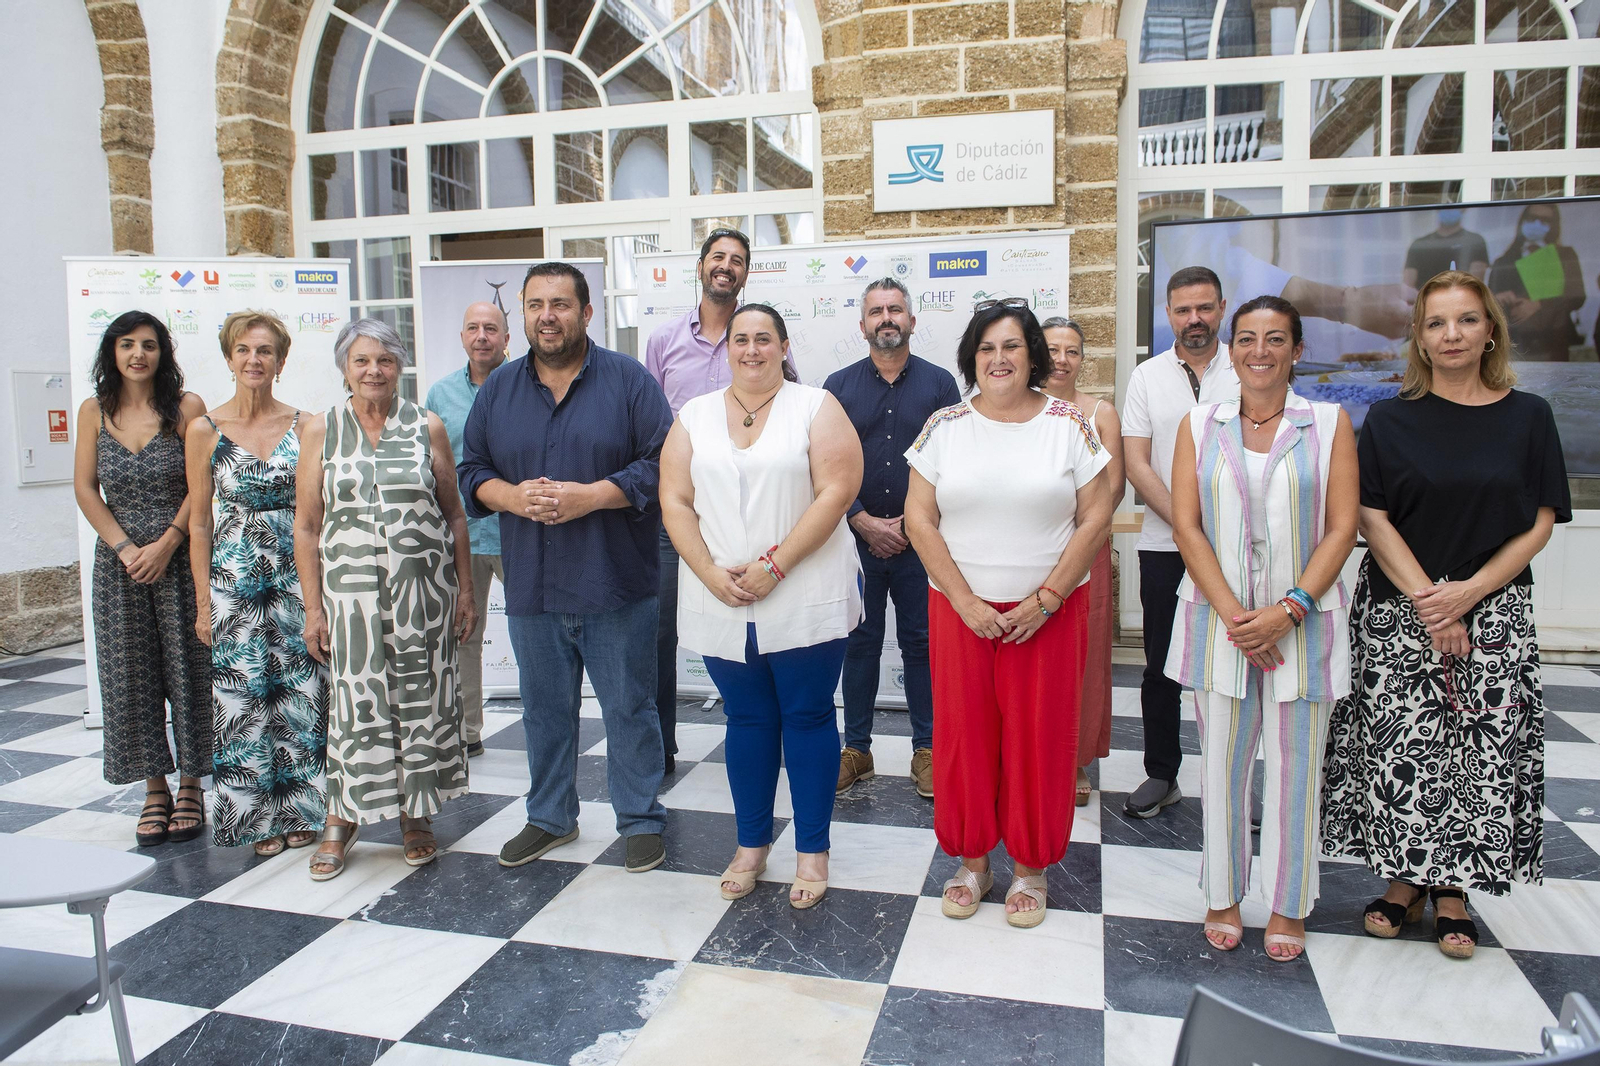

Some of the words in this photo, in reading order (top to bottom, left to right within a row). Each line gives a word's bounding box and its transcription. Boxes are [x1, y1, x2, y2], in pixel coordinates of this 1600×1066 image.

[956, 139, 1044, 161] Diputación
[956, 166, 976, 182] de
[982, 163, 1028, 181] Cádiz
[754, 262, 765, 271] DE
[936, 257, 980, 270] makro
[298, 272, 334, 282] makro
[922, 290, 956, 304] CHEF
[1032, 295, 1058, 311] Janda
[812, 304, 836, 319] Janda
[918, 295, 942, 314] Janda
[301, 312, 335, 324] CHEF
